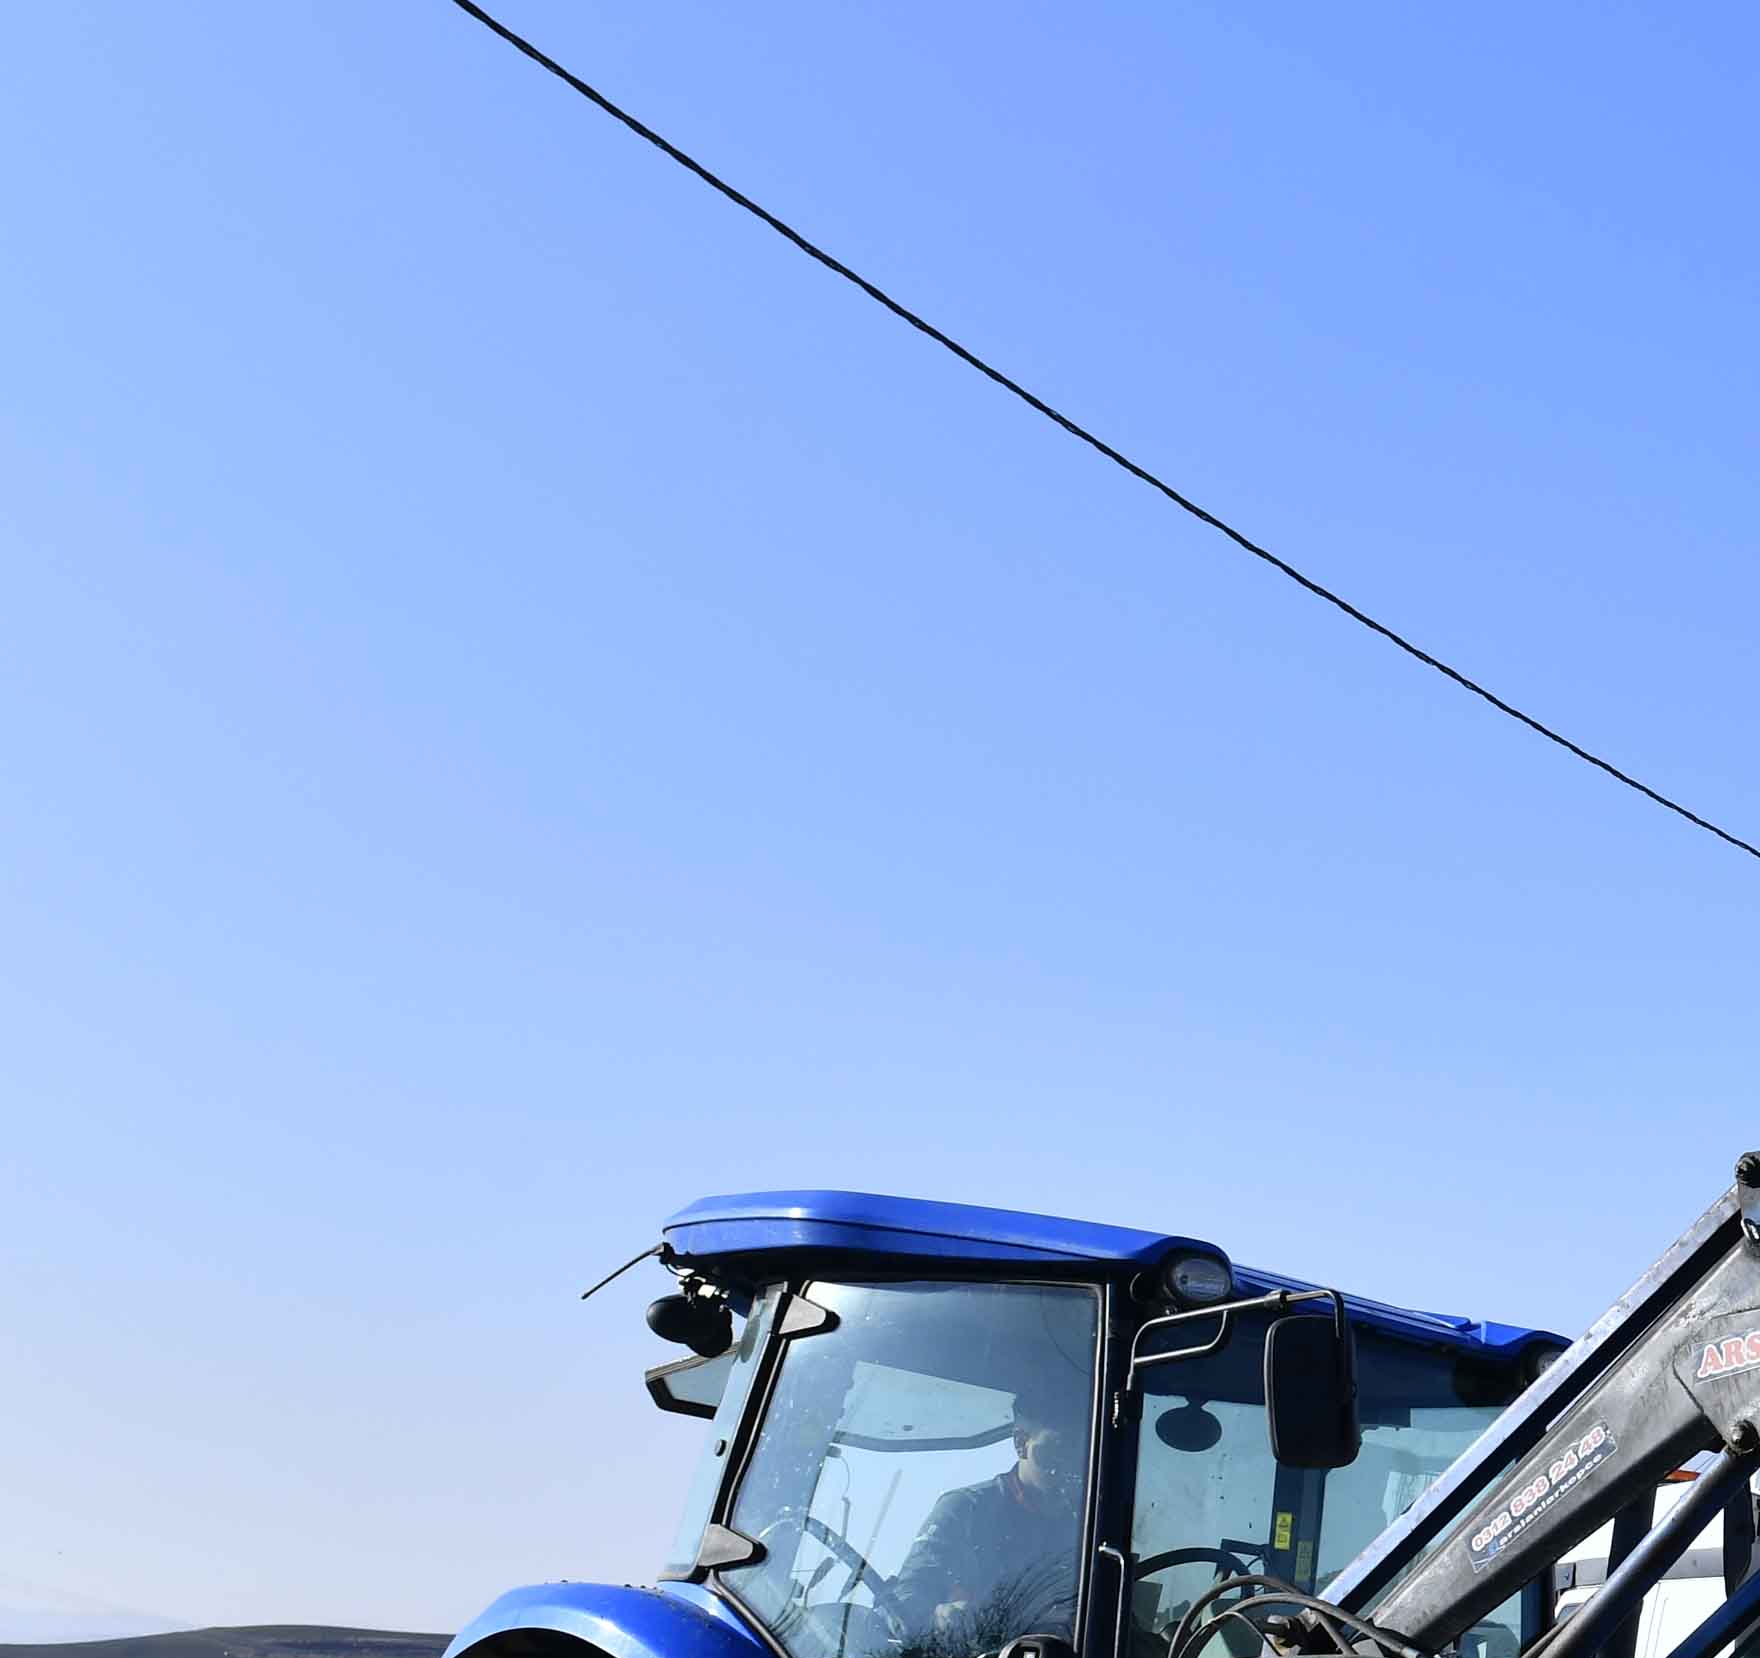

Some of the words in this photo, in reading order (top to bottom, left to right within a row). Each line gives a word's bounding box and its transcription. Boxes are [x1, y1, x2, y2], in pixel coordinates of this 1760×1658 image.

[1472, 1512, 1512, 1551] 0312
[1510, 1475, 1550, 1517] 838
[1549, 1450, 1578, 1484] 24
[1578, 1426, 1606, 1459] 48
